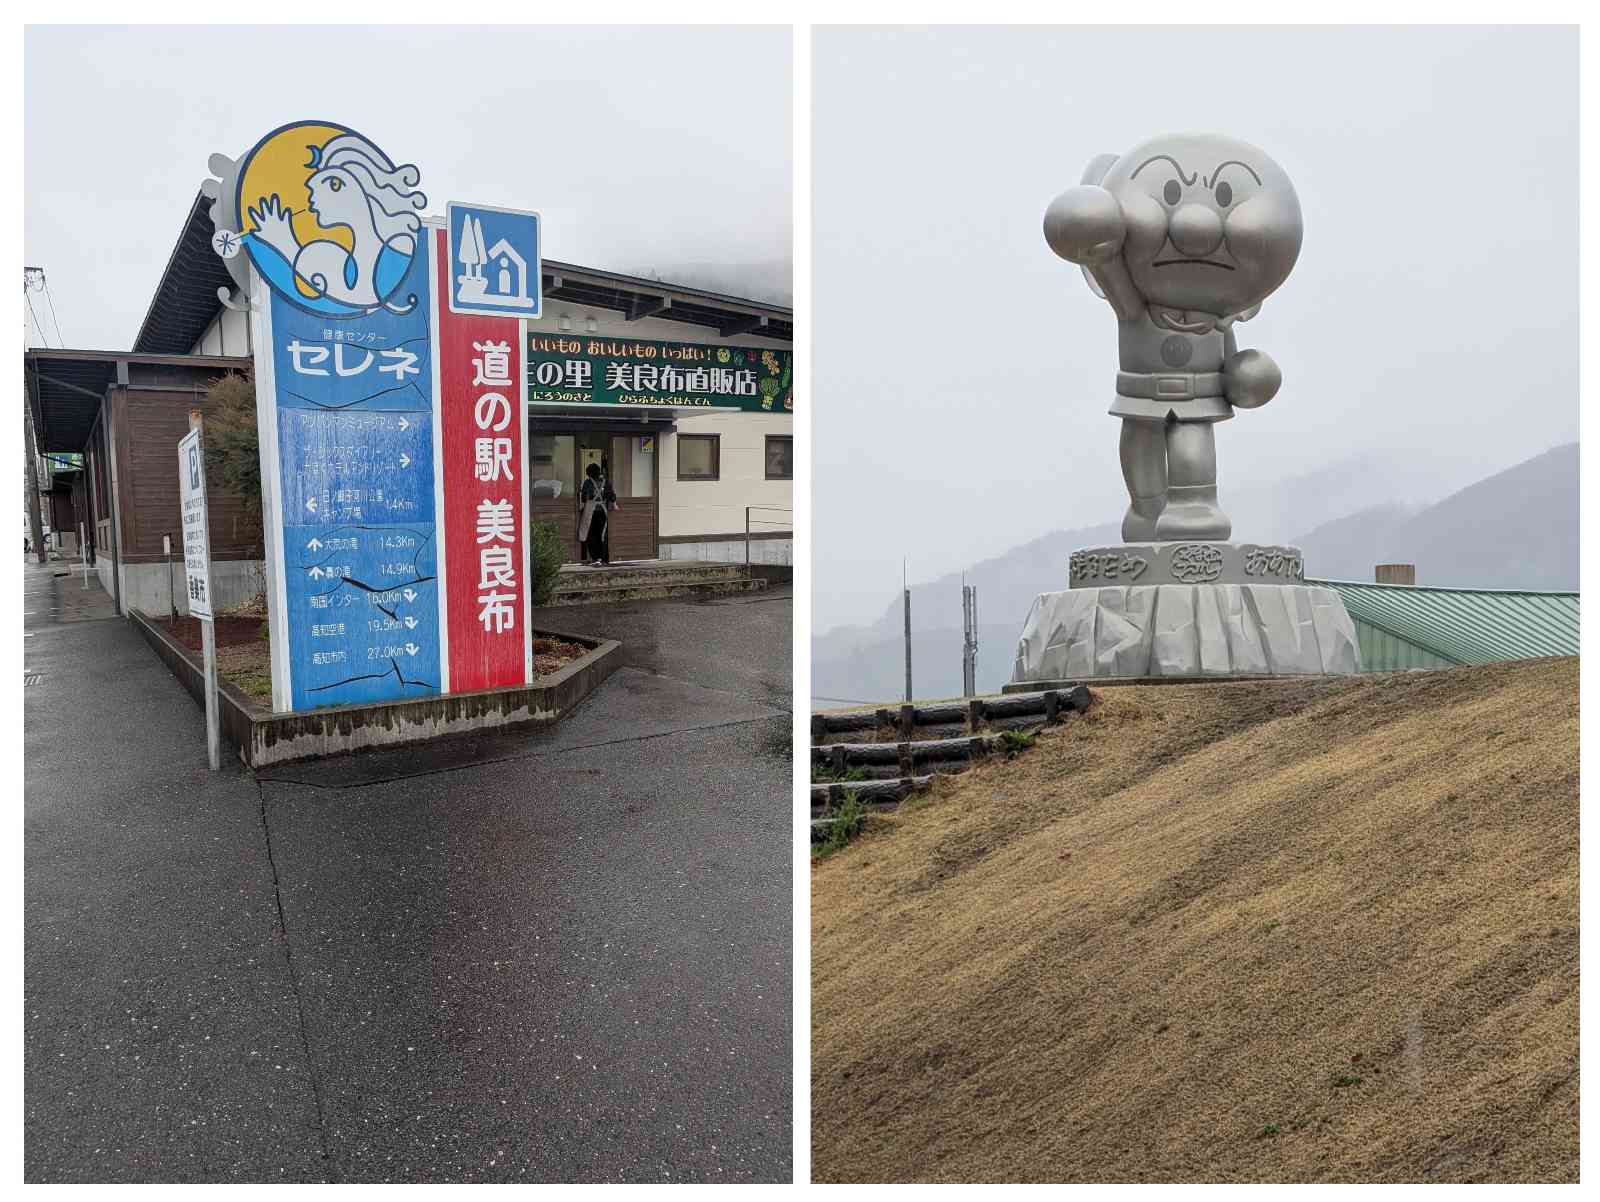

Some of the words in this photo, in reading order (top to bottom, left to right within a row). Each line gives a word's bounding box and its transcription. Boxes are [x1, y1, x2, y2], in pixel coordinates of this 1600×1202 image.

[287, 340, 420, 380] セレネ
[532, 338, 581, 354] いいもの
[587, 341, 657, 358] おいしいもの
[605, 361, 759, 396] 美良布直販店
[472, 340, 514, 481] 道の駅
[380, 536, 416, 549] 14.3Km
[381, 563, 416, 576] 14.9Km
[476, 498, 517, 634] 美良布
[368, 645, 404, 660] 27.0Km
